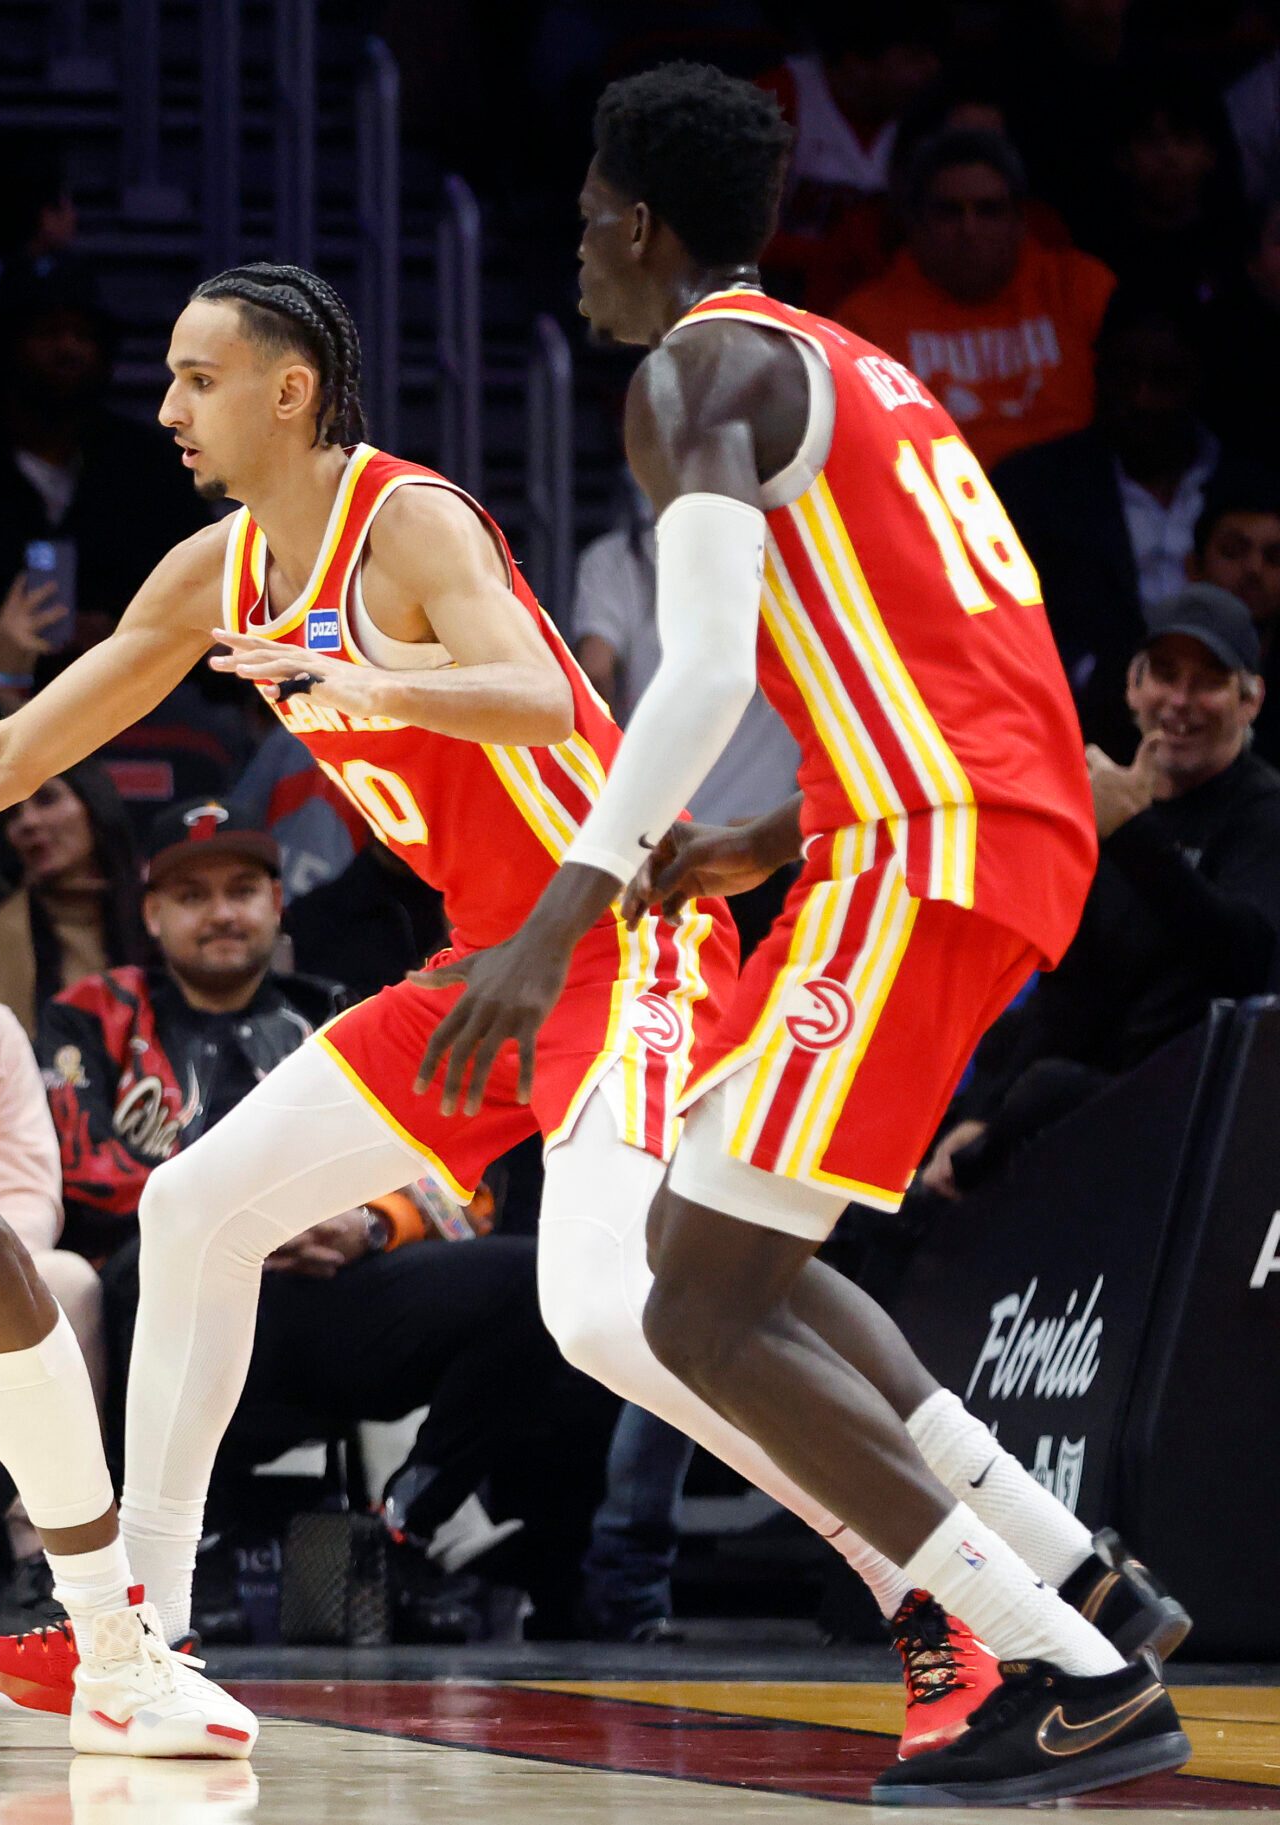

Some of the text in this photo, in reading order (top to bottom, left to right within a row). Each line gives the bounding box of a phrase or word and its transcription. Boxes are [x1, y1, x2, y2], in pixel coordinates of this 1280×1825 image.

[894, 434, 1044, 615] 18
[310, 621, 339, 641] paze
[965, 1273, 1104, 1401] Florida
